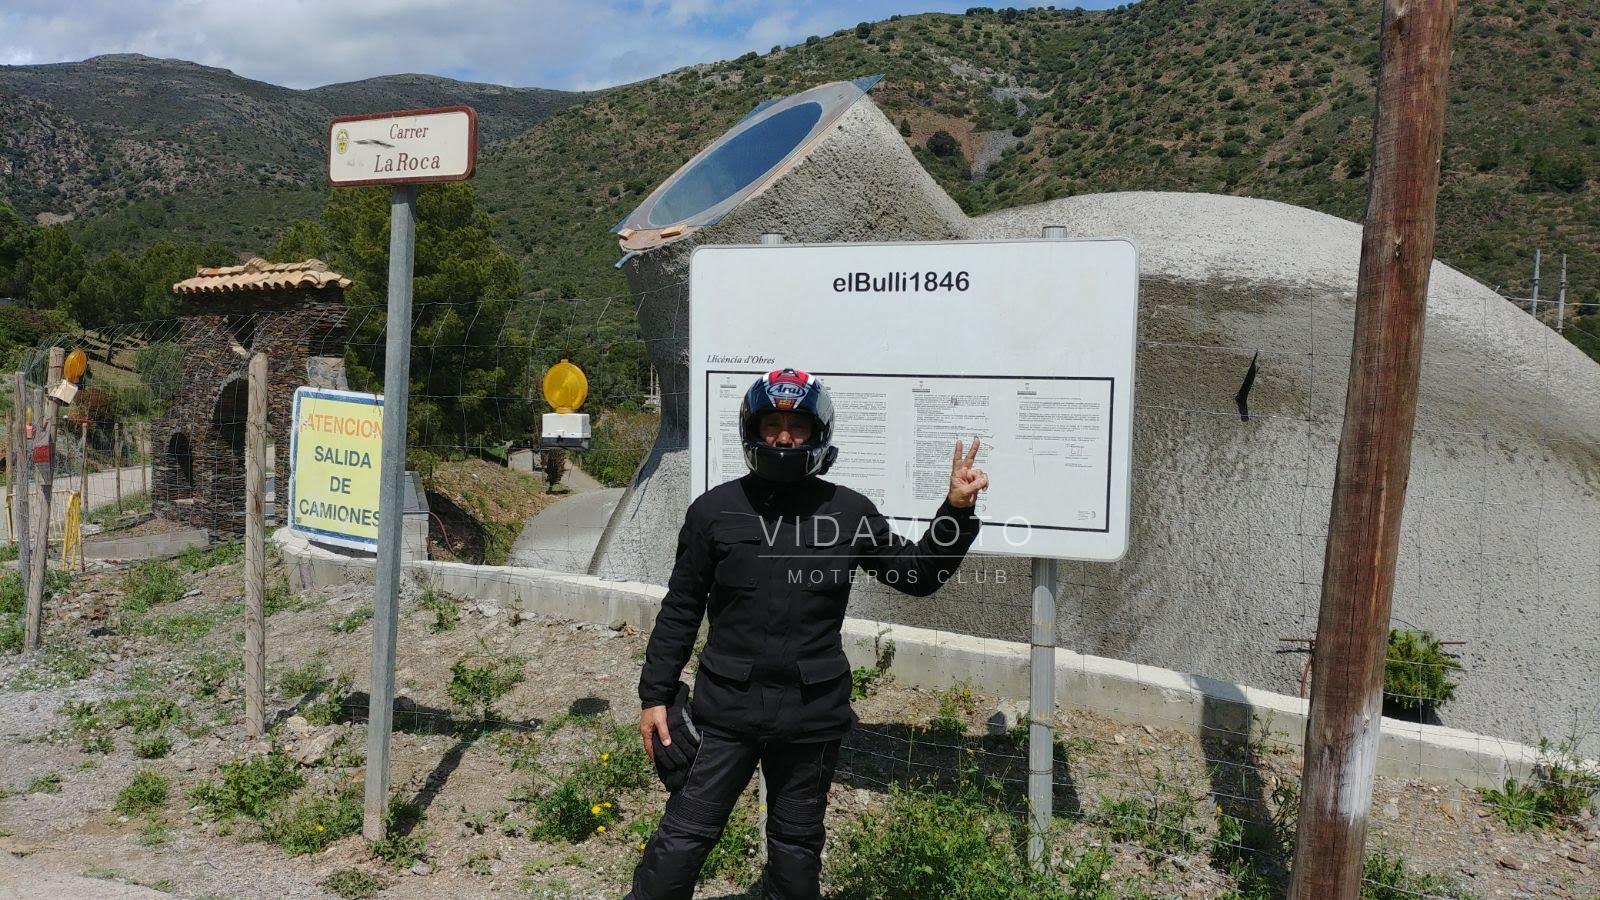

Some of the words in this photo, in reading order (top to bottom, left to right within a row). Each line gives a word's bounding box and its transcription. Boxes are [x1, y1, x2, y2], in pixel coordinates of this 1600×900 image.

[389, 123, 429, 140] Carrer
[832, 270, 971, 294] elBulli1846
[770, 384, 802, 395] Arai
[314, 445, 372, 469] SALIDA
[330, 475, 351, 494] DE
[299, 499, 380, 526] CAMIONES
